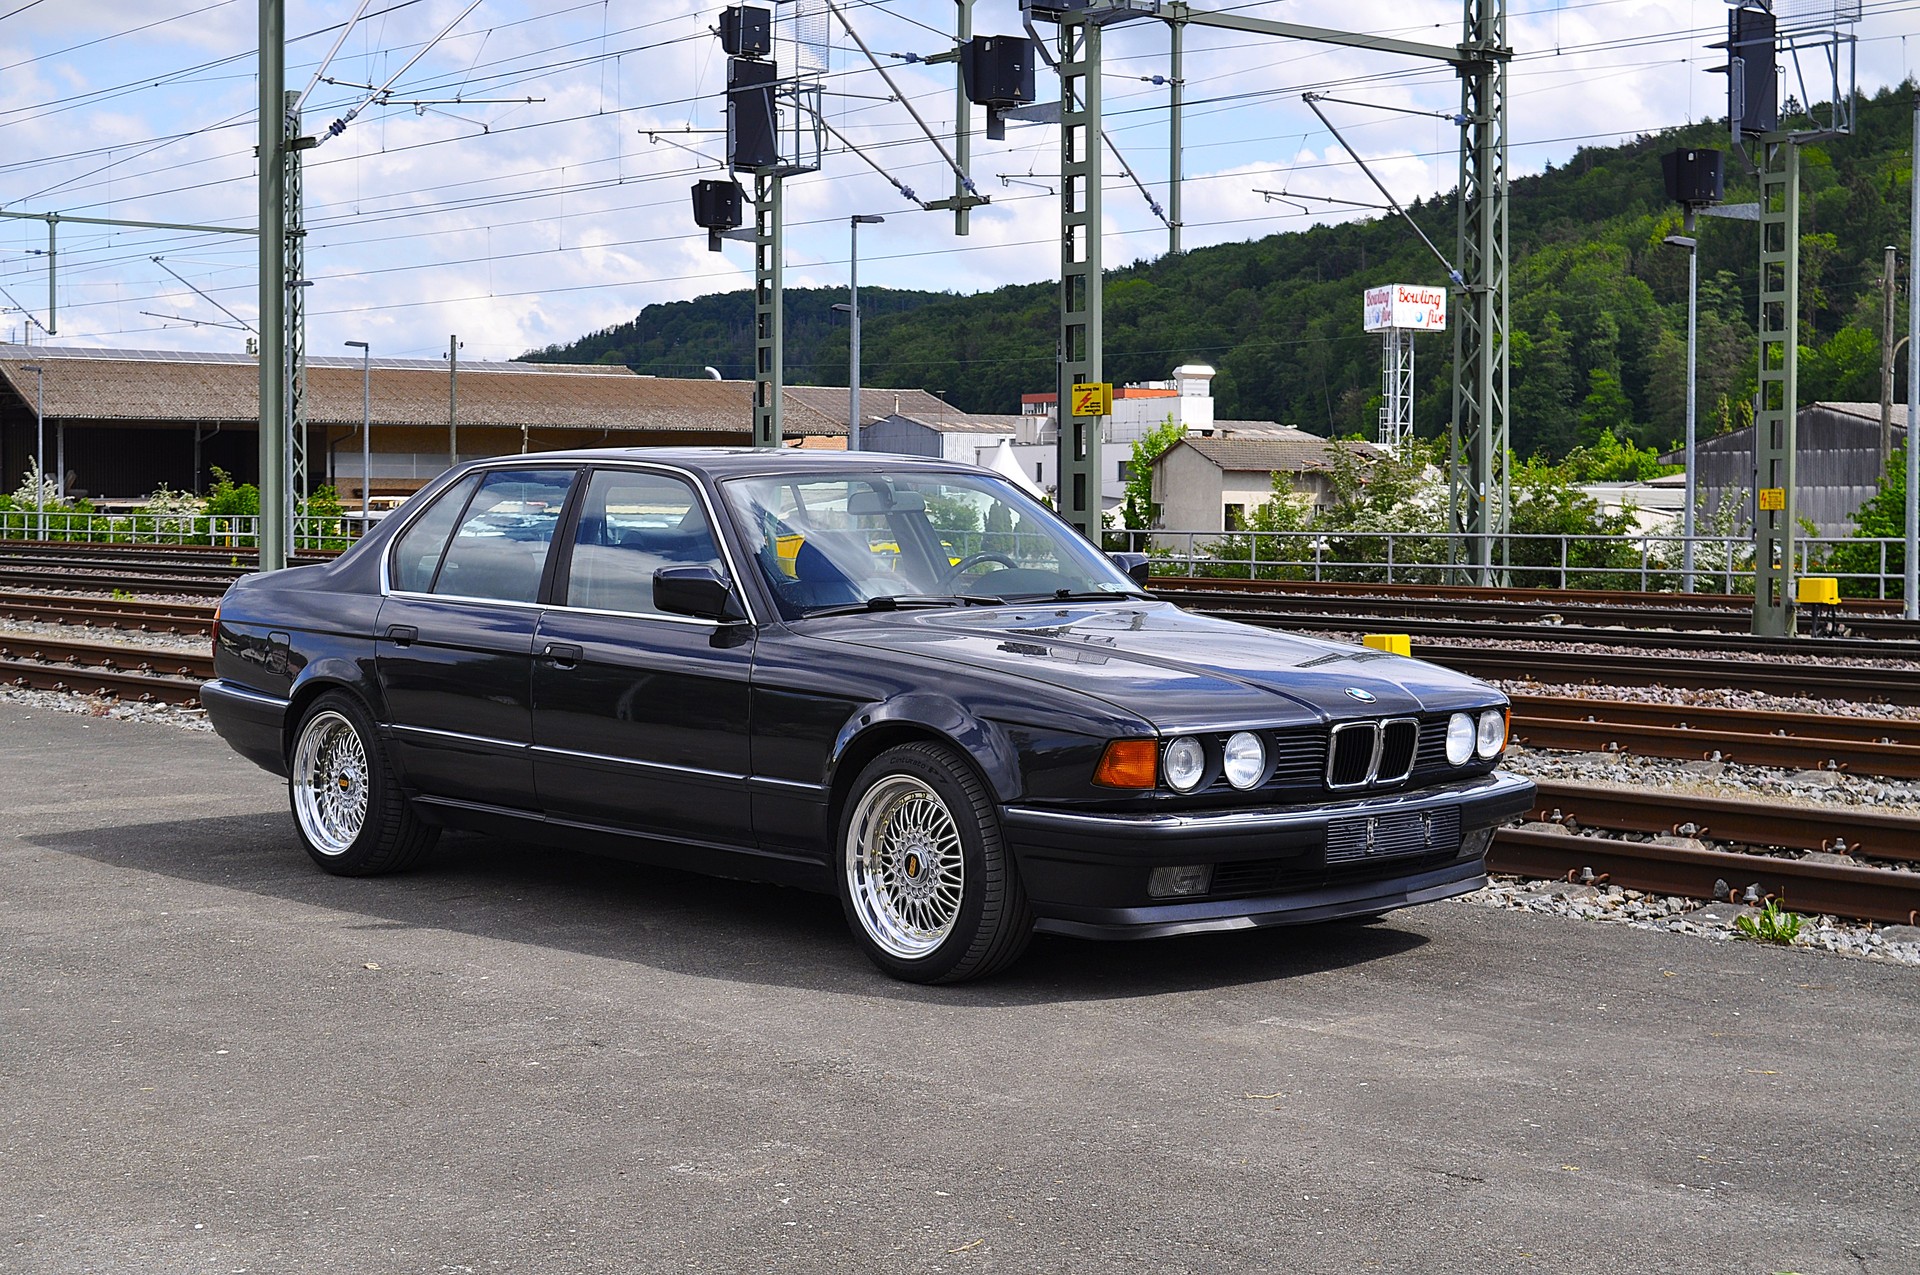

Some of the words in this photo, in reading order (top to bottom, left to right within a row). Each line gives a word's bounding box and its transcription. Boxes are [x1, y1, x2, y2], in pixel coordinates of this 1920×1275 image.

[1366, 289, 1389, 307] Bowling
[1398, 286, 1441, 309] Bowling
[1426, 309, 1444, 327] five
